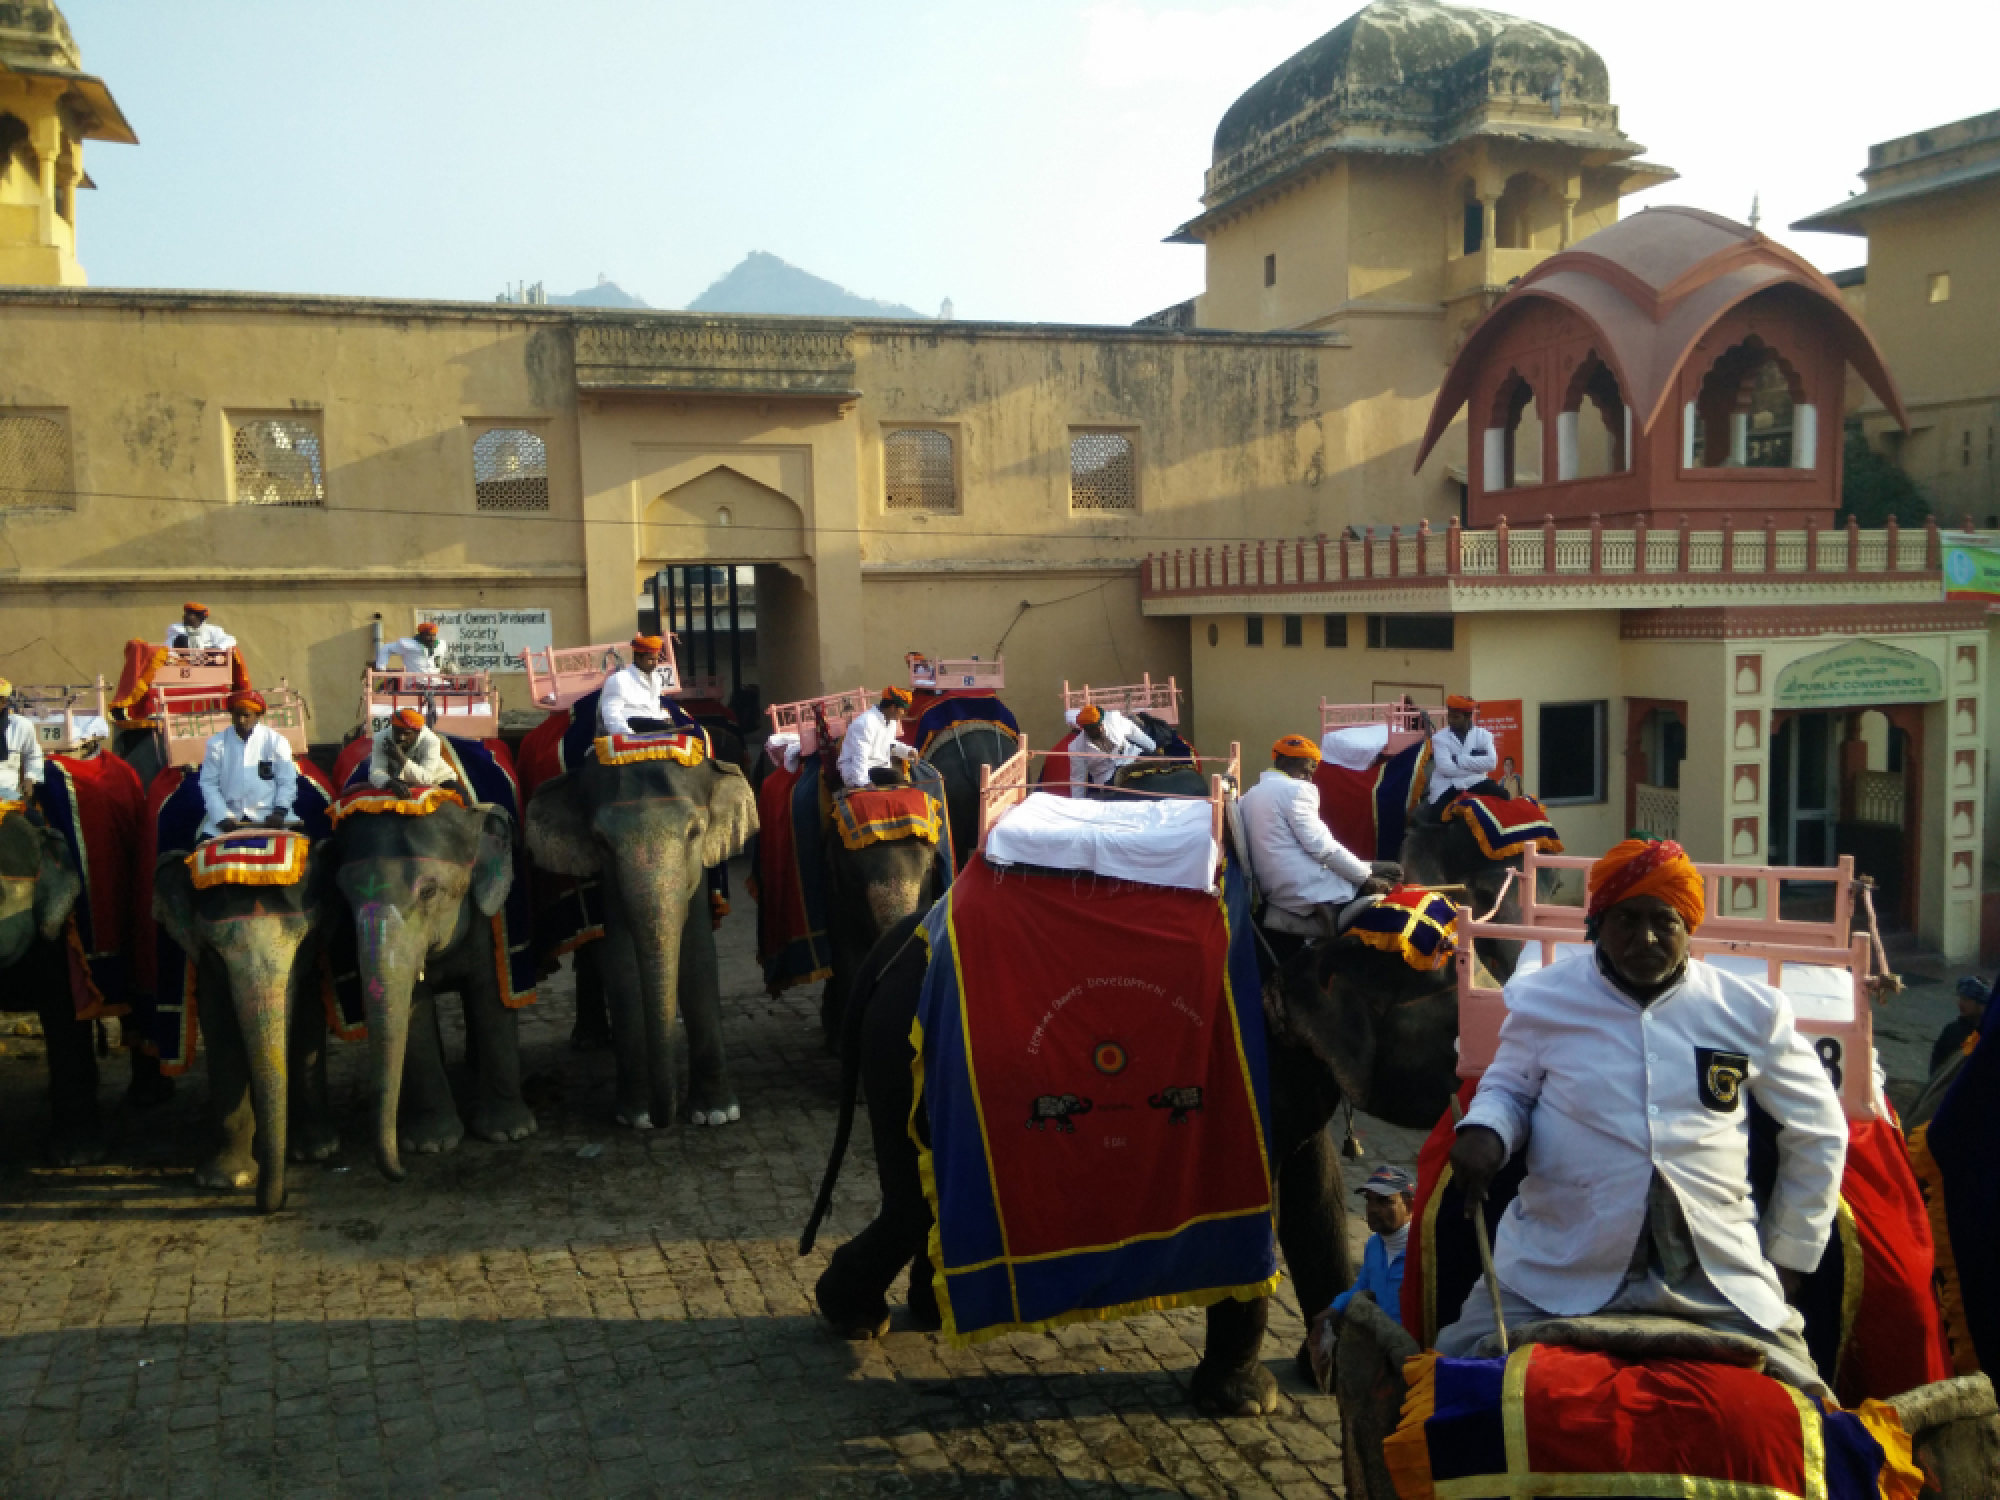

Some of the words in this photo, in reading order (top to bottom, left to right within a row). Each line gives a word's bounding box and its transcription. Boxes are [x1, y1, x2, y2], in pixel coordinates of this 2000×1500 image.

[460, 627, 498, 641] Society
[1797, 681, 1840, 691] PUBLIC
[1842, 677, 1925, 690] CONVENIENCE
[43, 727, 61, 741] 78
